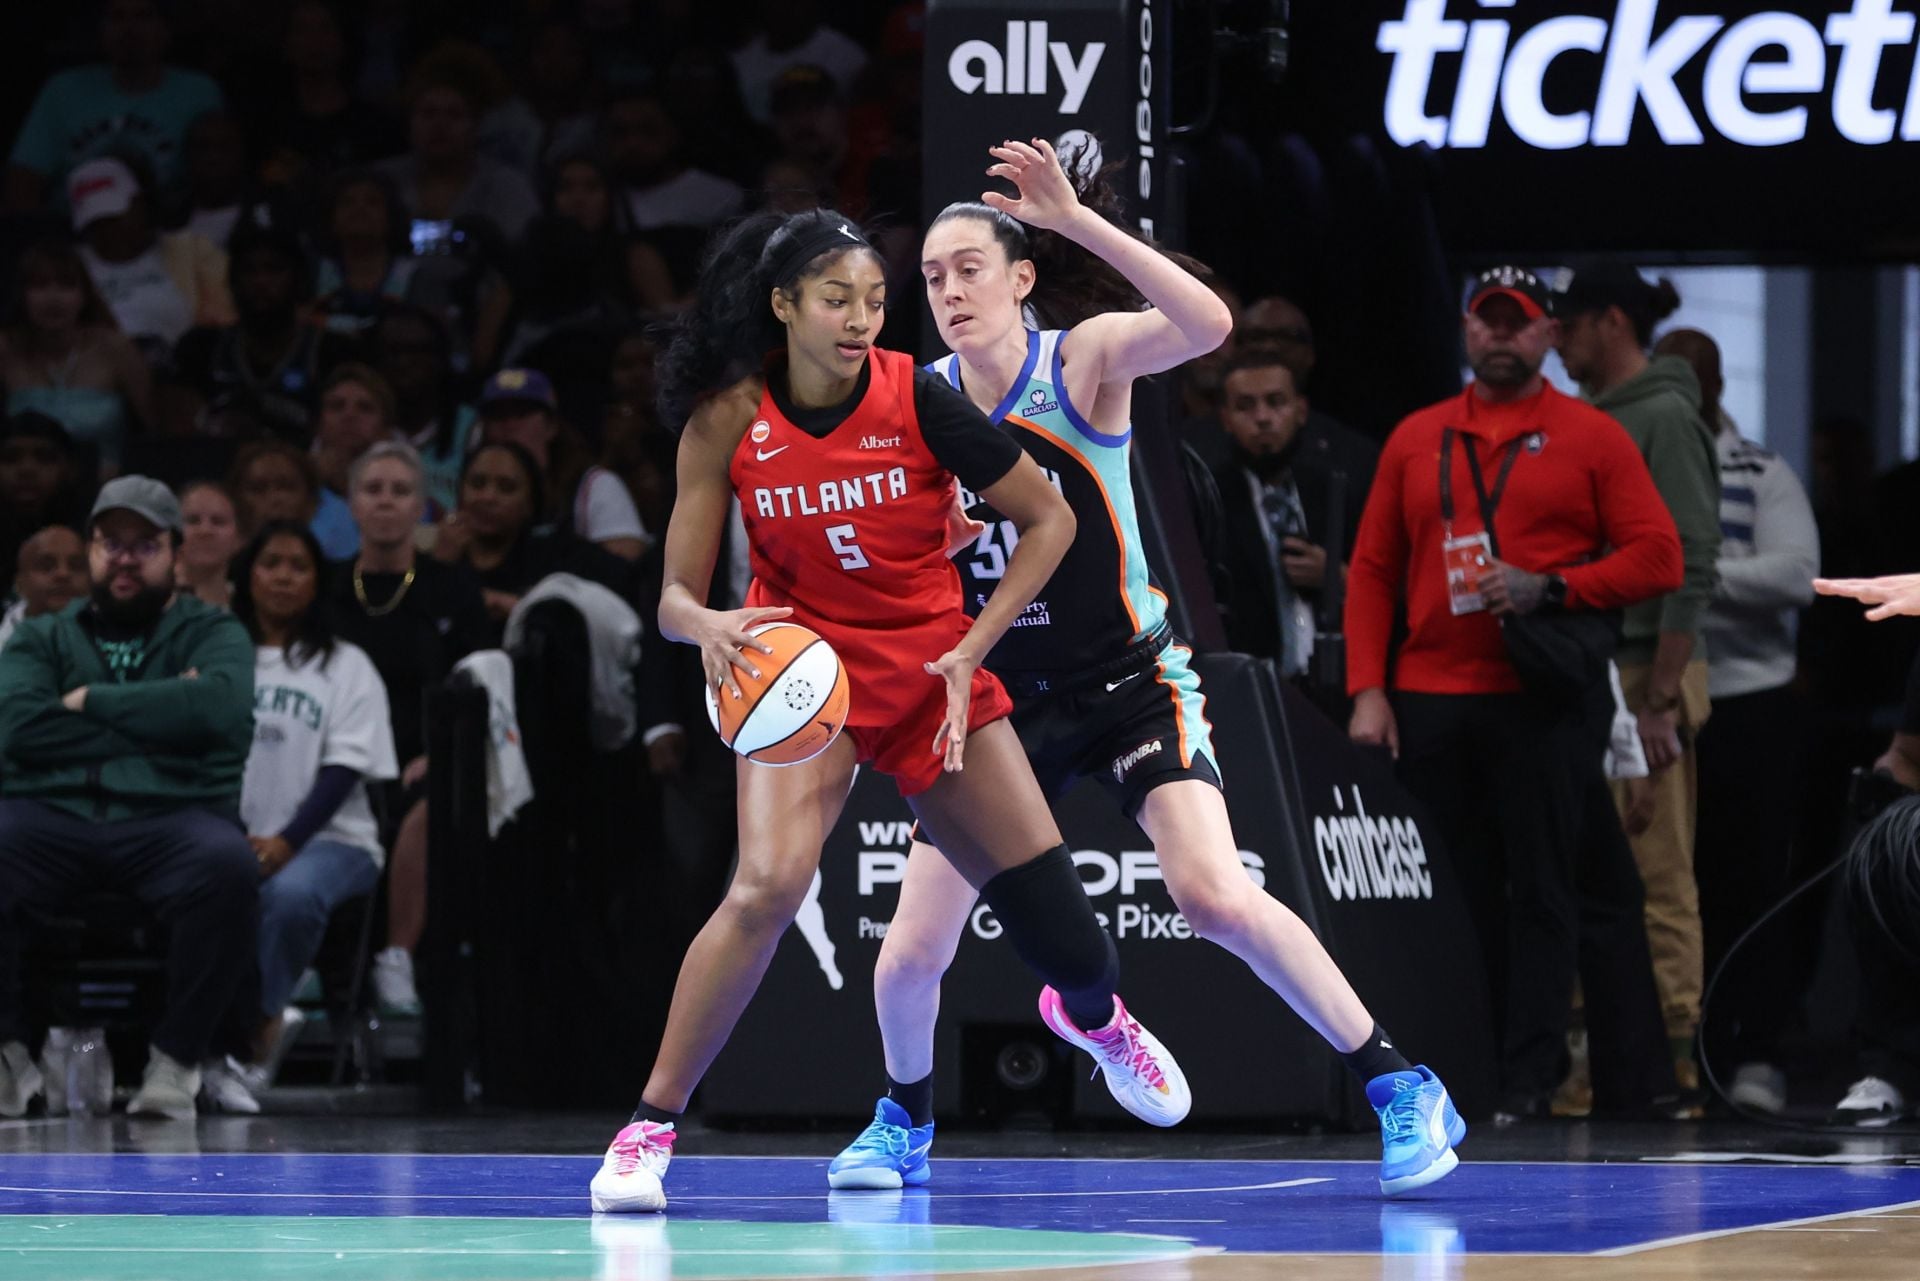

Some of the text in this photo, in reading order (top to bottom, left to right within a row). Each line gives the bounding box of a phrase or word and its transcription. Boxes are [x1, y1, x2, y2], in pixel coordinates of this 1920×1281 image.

[948, 20, 1106, 114] ally
[1376, 0, 1920, 149] ticket
[1137, 0, 1154, 200] oogle
[1023, 402, 1057, 416] BARCLAYS
[859, 435, 901, 449] Albert
[754, 466, 907, 518] ATLANTA
[824, 523, 870, 570] 5
[1010, 611, 1051, 627] utual
[1122, 740, 1162, 771] WNBA
[1314, 783, 1432, 901] coinbase
[1117, 903, 1201, 939] Pixe
